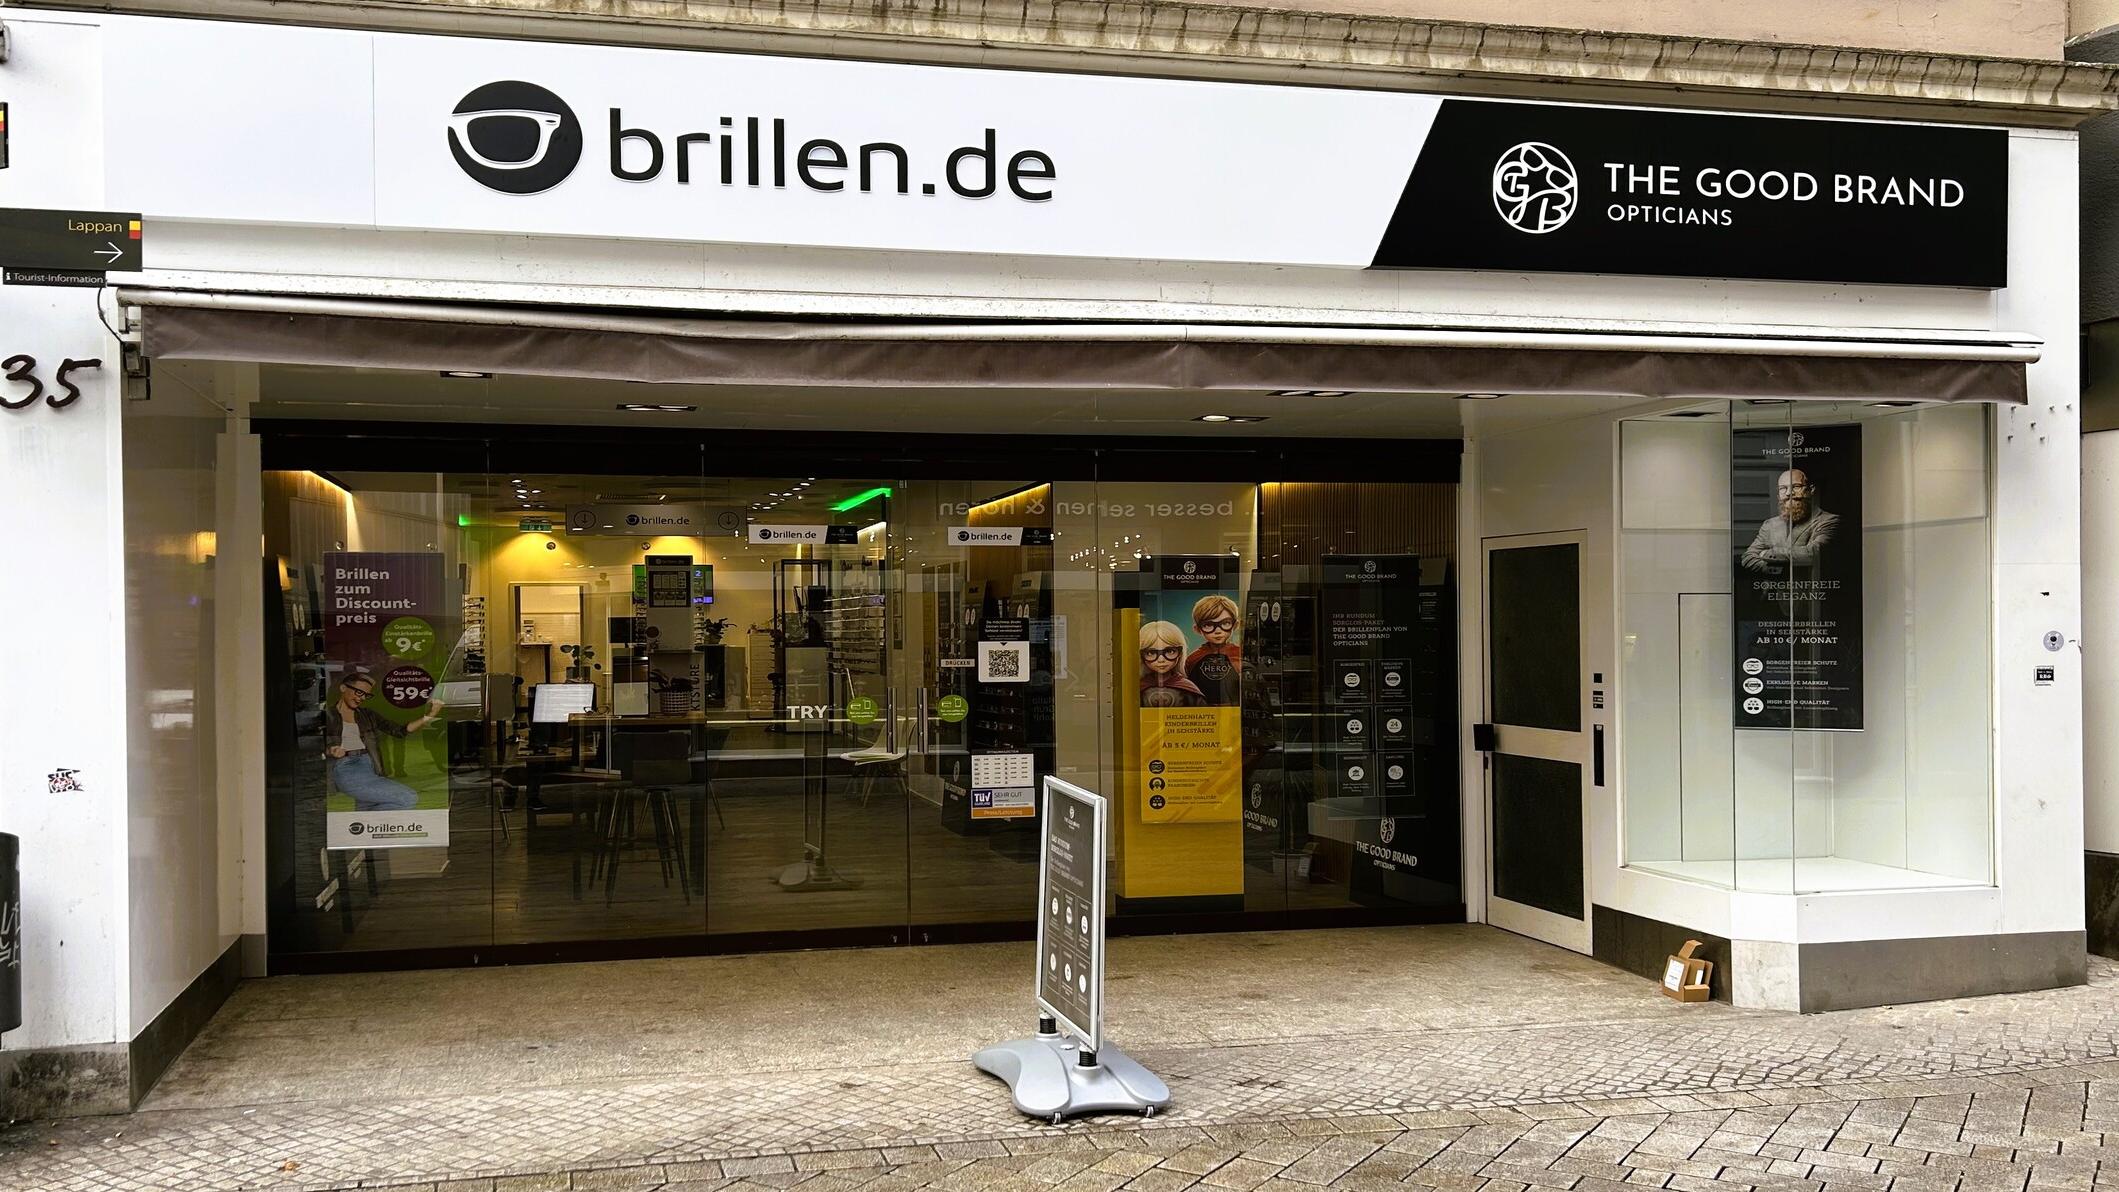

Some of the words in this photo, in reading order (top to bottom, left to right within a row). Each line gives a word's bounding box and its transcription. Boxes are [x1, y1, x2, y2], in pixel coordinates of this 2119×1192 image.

[610, 106, 1057, 203] brillen.de
[1604, 162, 1681, 196] THE
[1696, 169, 1819, 203] GOOD
[1834, 174, 1965, 208] BRAND
[1606, 204, 1733, 227] OPTICIANS
[68, 219, 122, 234] Lappan
[14, 272, 104, 284] Tourist-Information
[0, 354, 103, 410] 35
[1778, 447, 1803, 455] GOOD
[641, 515, 690, 526] brillen.de
[772, 529, 818, 540] brillen.de
[970, 530, 1013, 542] brillen.de
[335, 567, 390, 580] Brillen
[335, 584, 371, 594] zum
[1753, 580, 1841, 590] SORGENFREIE
[1767, 592, 1827, 601] ELEGANZ
[335, 597, 417, 609] Discount-
[335, 611, 377, 627] preis
[1756, 636, 1770, 644] AB
[1773, 636, 1784, 644] 10
[1801, 636, 1839, 644] MONAT
[786, 705, 828, 719] TRY
[1244, 809, 1260, 823] GOOD
[1260, 814, 1278, 828] BRAND
[366, 822, 423, 833] brillen.de
[1356, 841, 1369, 855] THE
[1370, 844, 1391, 860] GOOD
[1392, 849, 1418, 867] BRAND
